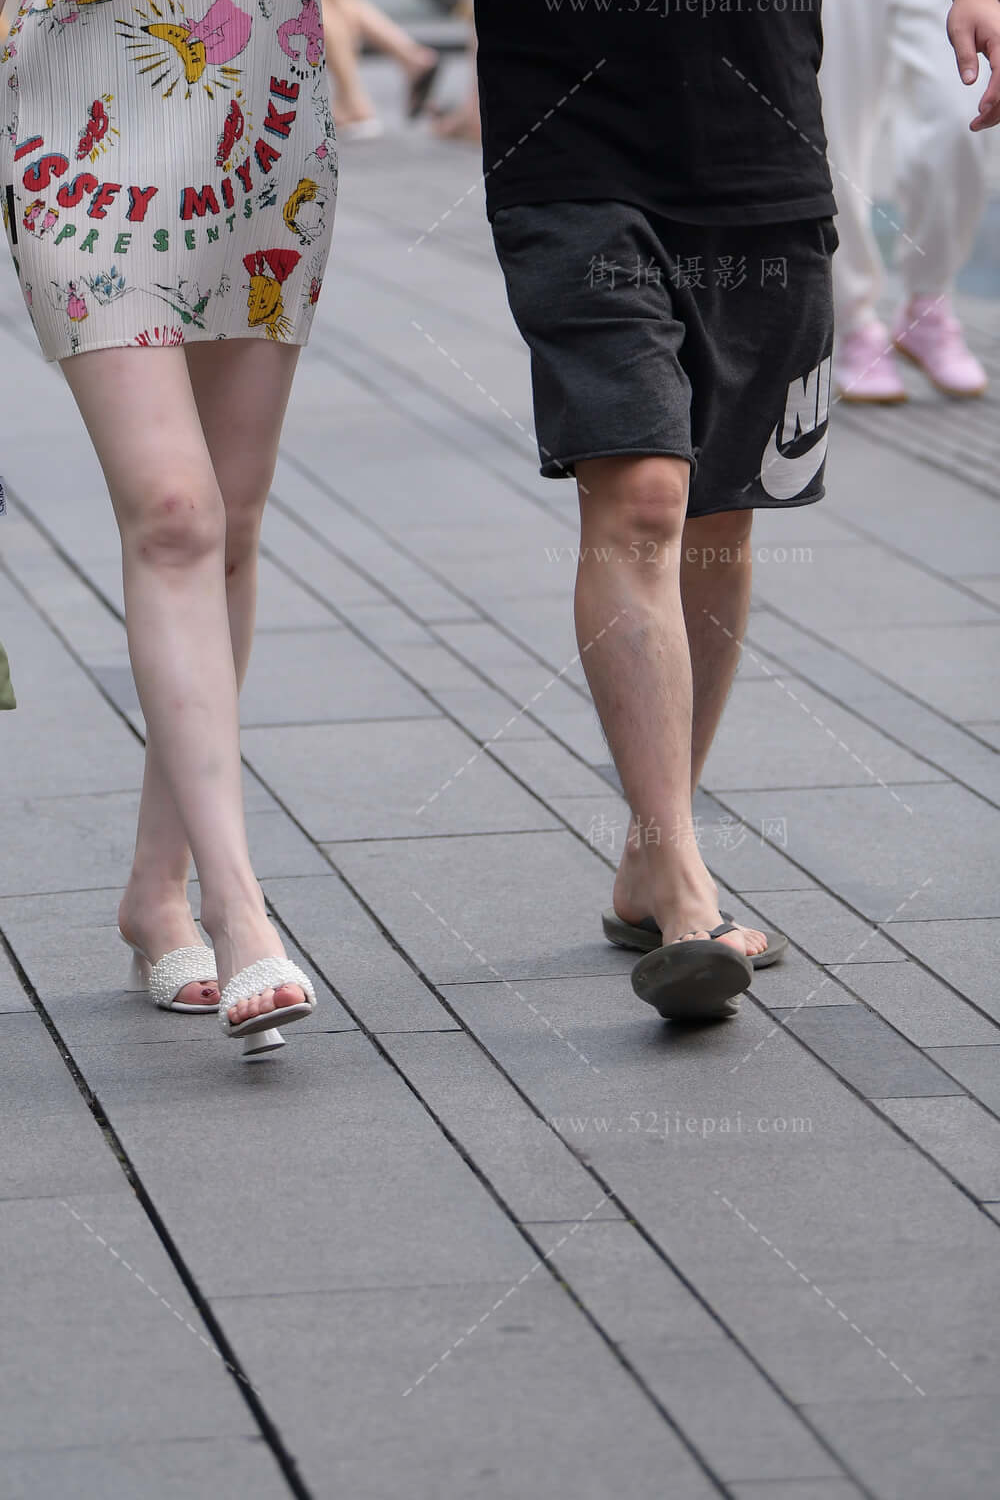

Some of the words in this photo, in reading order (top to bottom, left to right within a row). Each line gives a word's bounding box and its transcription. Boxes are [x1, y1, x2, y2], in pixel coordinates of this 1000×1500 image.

[14, 135, 159, 222] ISSEY
[180, 75, 301, 221] MIYAKE
[54, 198, 254, 254] PRESENTS
[781, 355, 831, 446] NI
